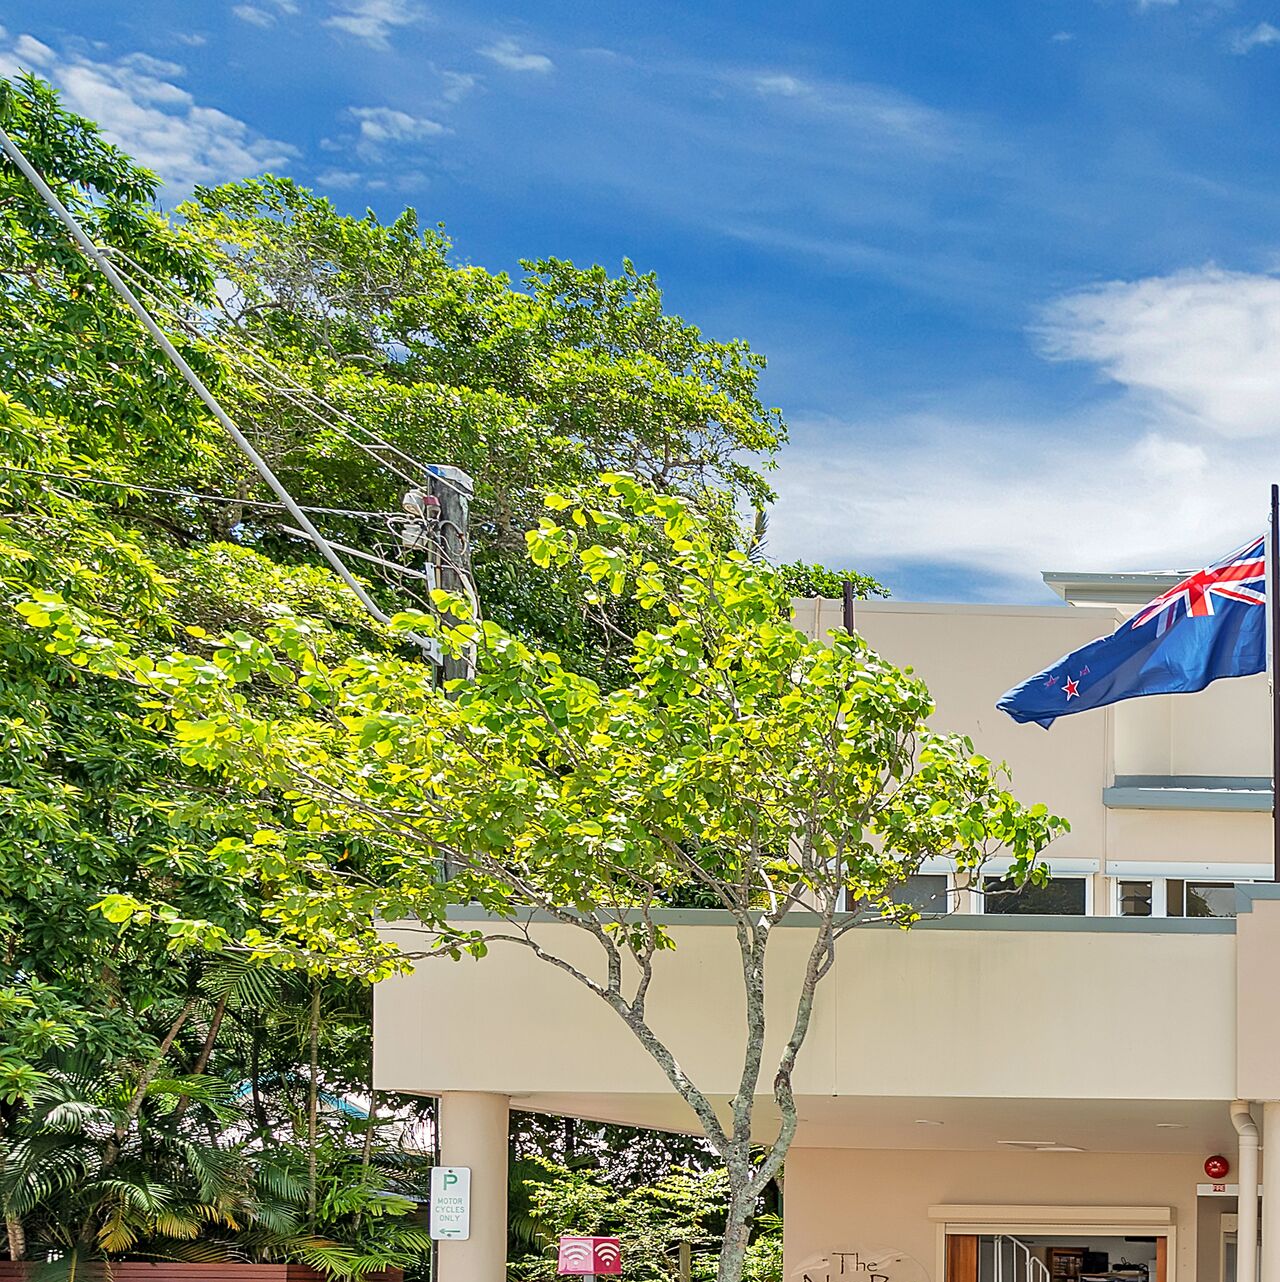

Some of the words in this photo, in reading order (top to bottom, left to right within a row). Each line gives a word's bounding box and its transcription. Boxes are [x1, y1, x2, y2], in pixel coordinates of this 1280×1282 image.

[443, 1174, 458, 1190] P
[437, 1197, 463, 1205] MOTOR
[439, 1214, 461, 1222] ONLY
[831, 1252, 878, 1275] The
